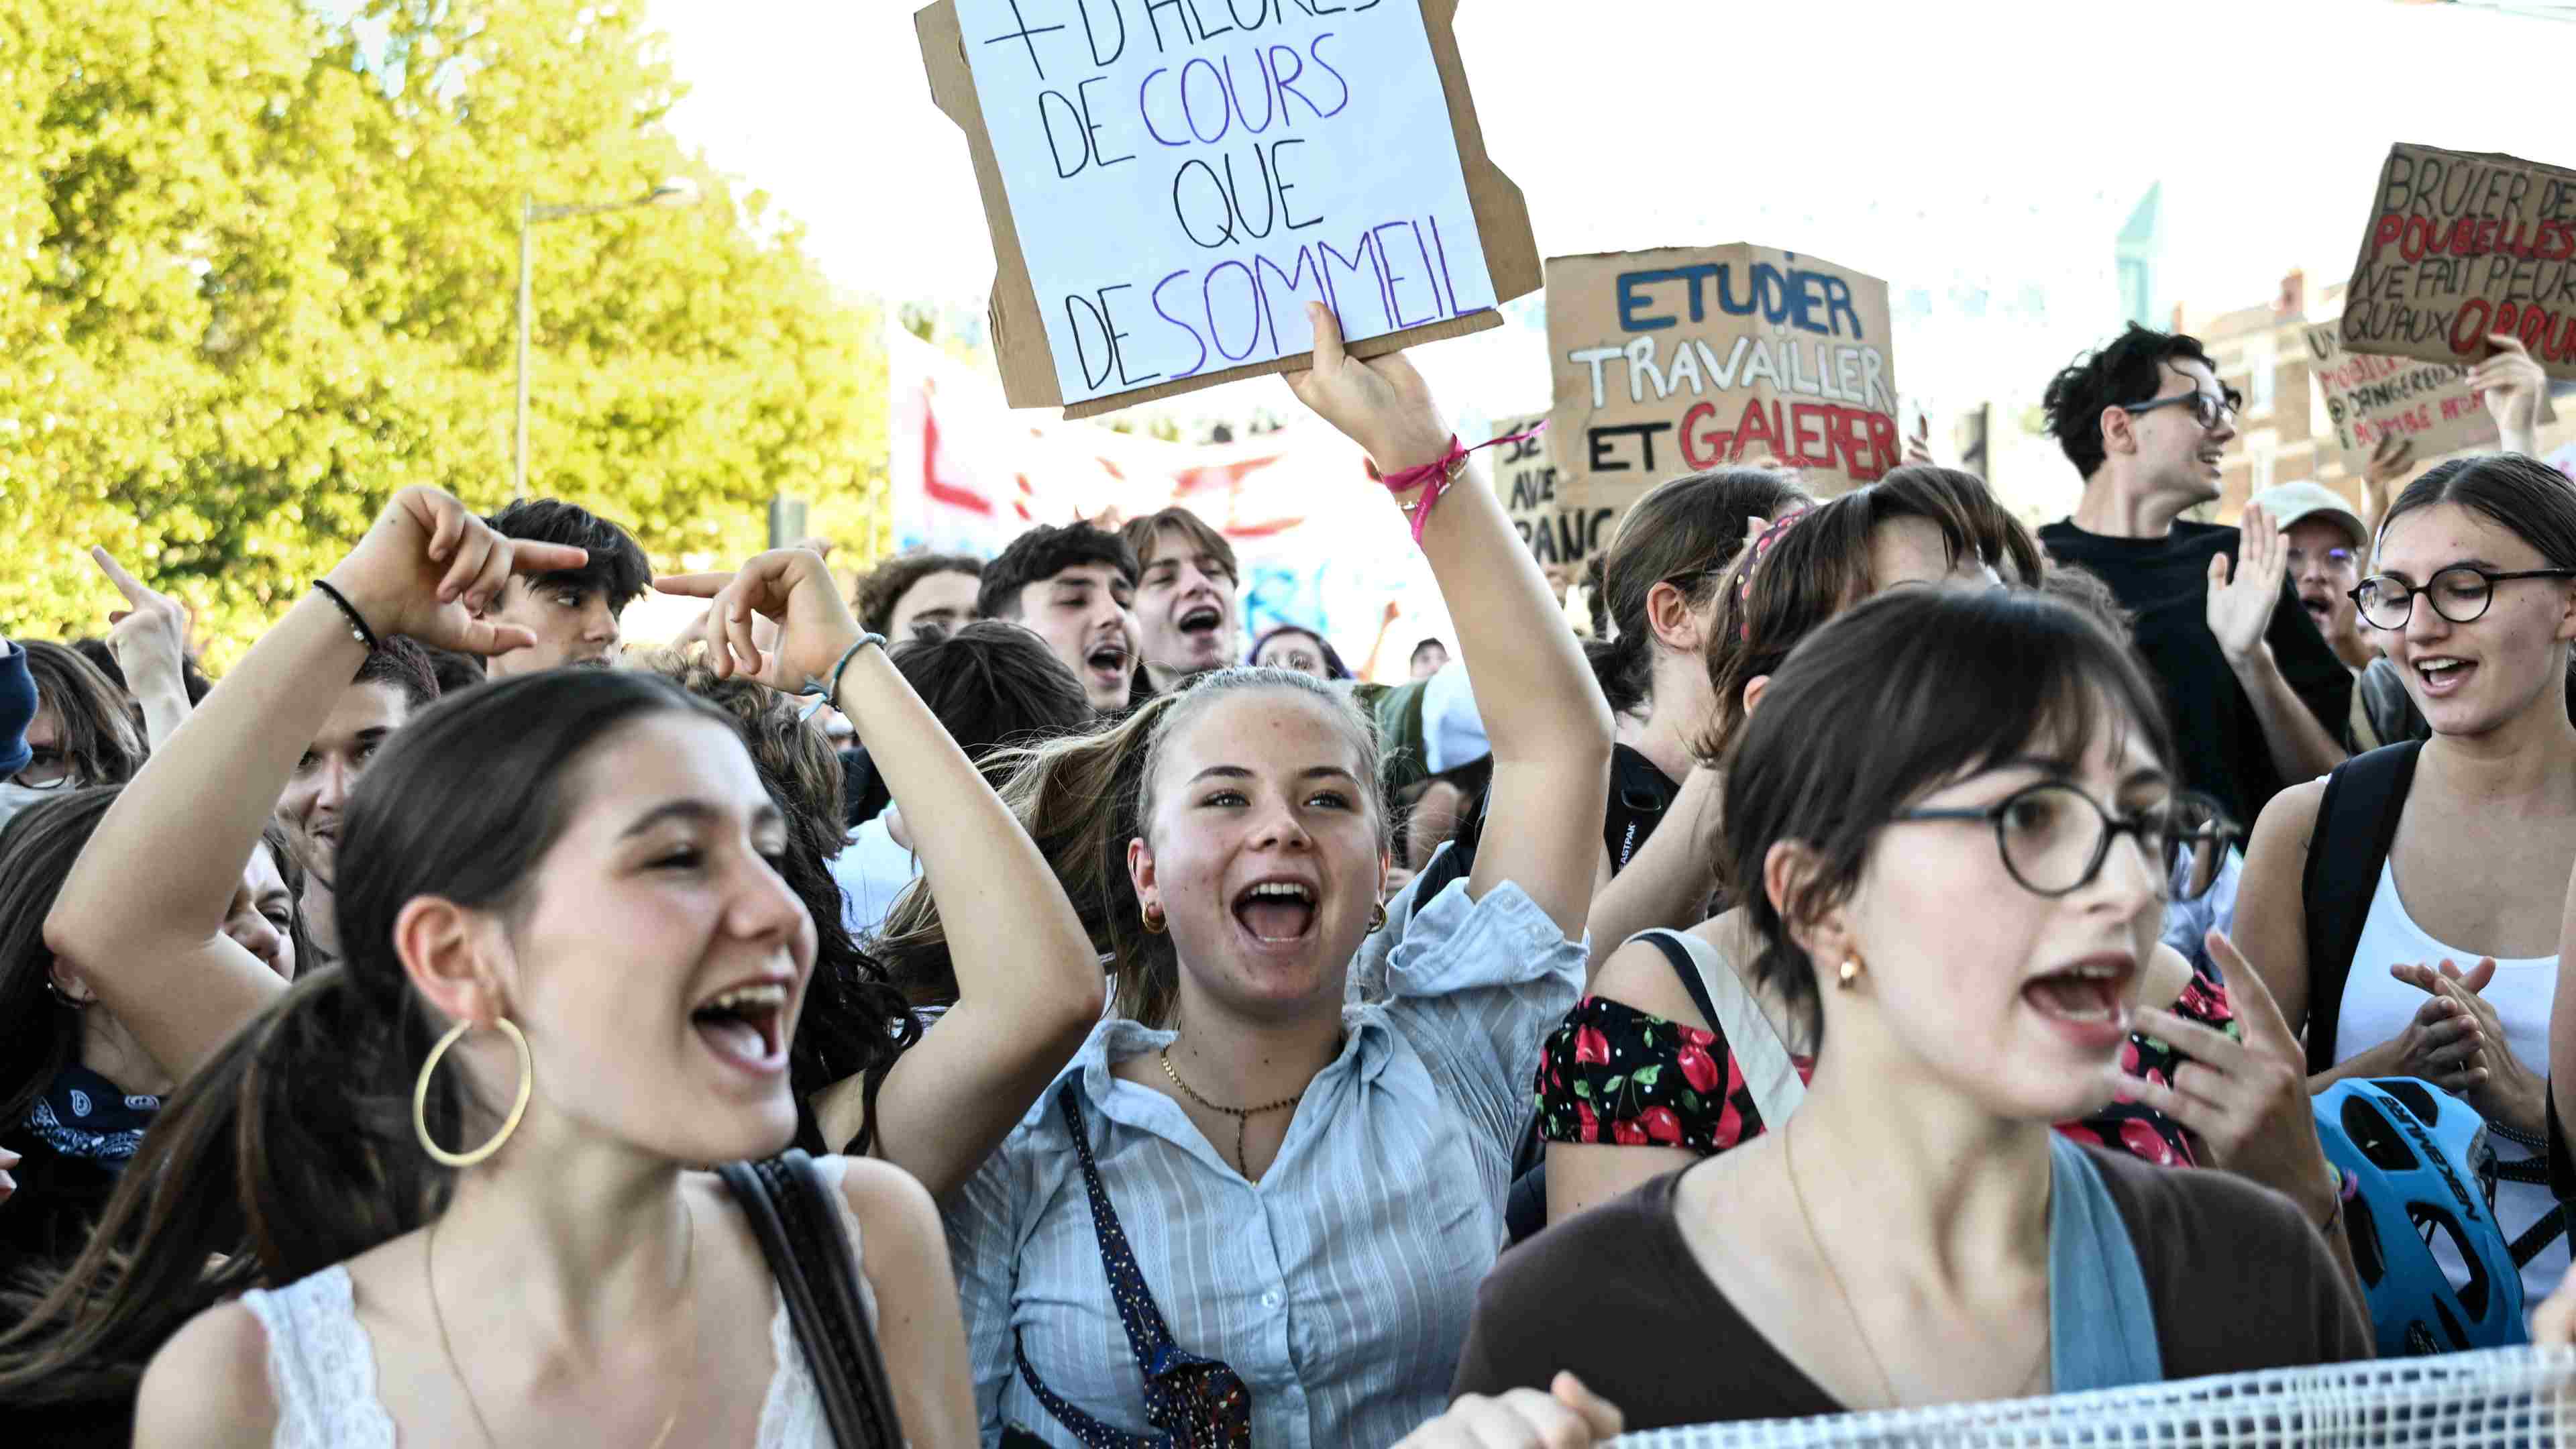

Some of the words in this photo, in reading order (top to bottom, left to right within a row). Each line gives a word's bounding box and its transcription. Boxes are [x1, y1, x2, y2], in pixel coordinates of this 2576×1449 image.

[1038, 76, 1135, 178] DE
[1140, 33, 1348, 146] COURS
[1173, 139, 1324, 248] QUE
[2370, 213, 2576, 265] POUBELLES
[1065, 283, 1161, 390] DE
[1152, 215, 1493, 379] SOMMEIL
[2349, 258, 2411, 299] NE
[2413, 252, 2481, 298] FAIT
[2484, 255, 2576, 303] PEUR
[1587, 421, 1672, 472] ET
[1678, 397, 1902, 482] GALERER
